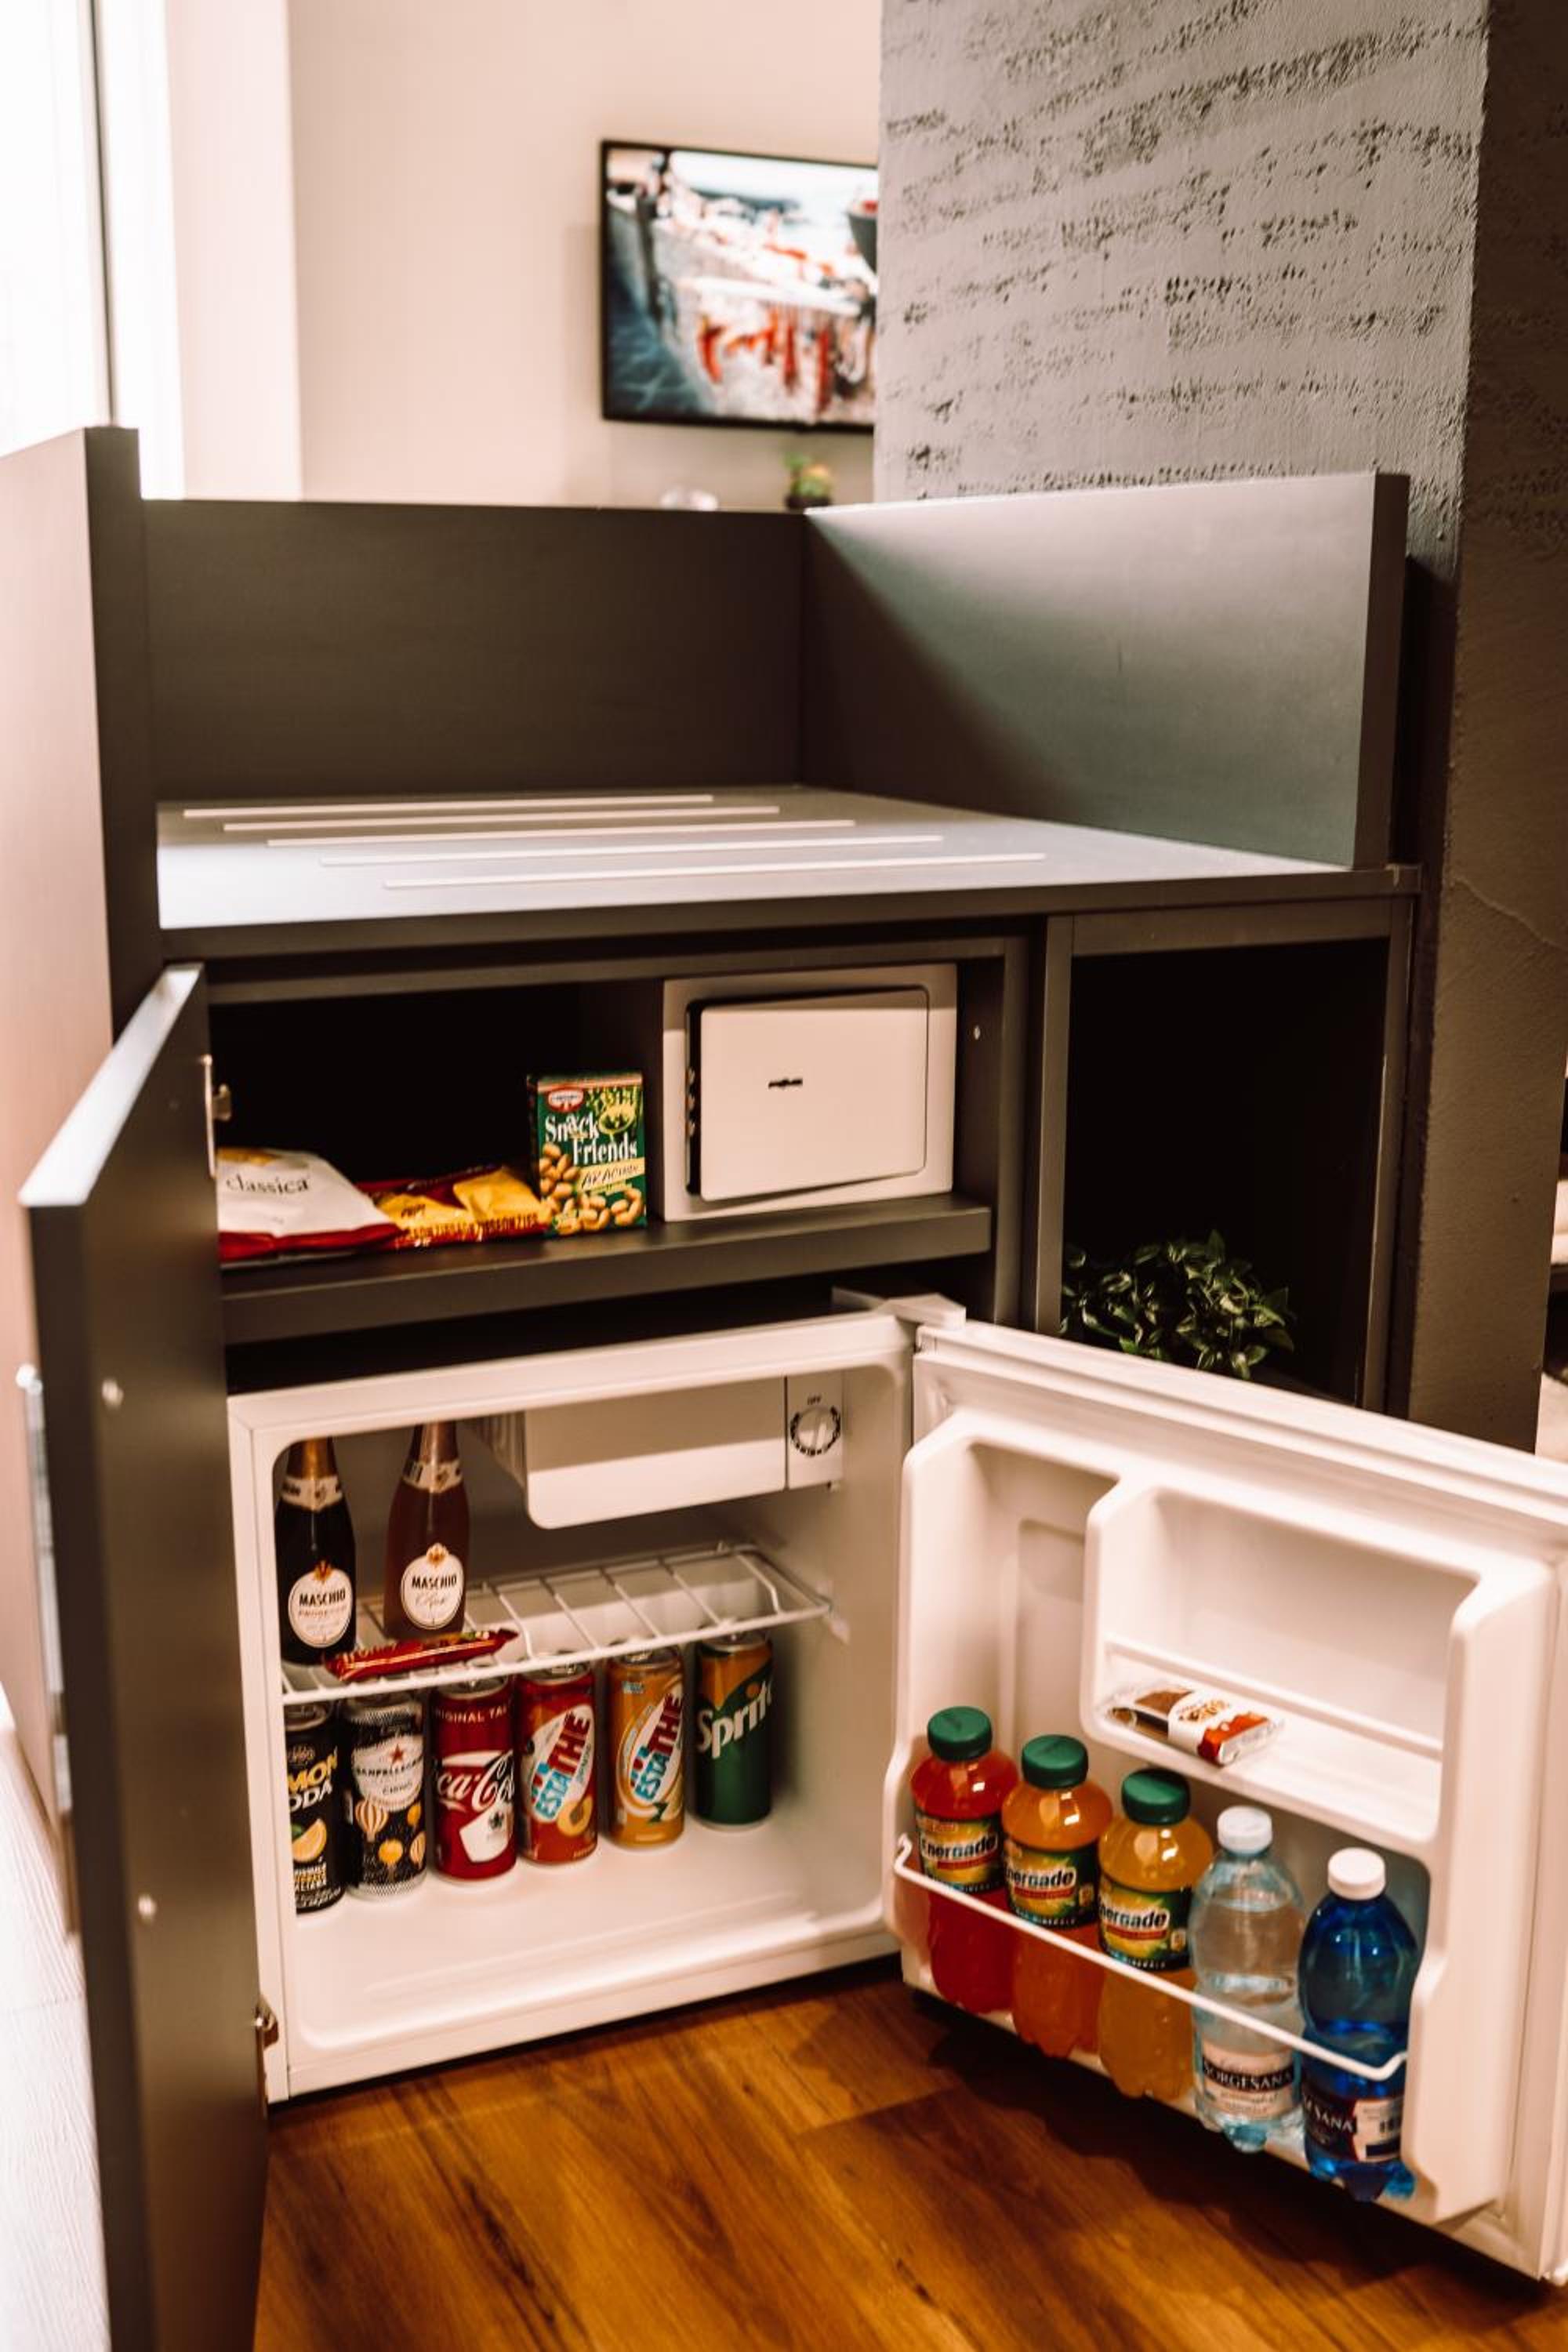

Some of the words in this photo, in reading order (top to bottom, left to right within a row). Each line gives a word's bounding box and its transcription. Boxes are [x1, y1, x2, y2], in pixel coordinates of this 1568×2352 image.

[545, 1111, 600, 1143] Snack
[573, 1131, 637, 1167] Friends
[226, 1174, 309, 1193] classica
[412, 1573, 457, 1591] MASCHIO
[299, 1588, 346, 1606] MASCHIO
[435, 1706, 485, 1724] RIGINAL
[288, 1746, 338, 1794] MON
[289, 1779, 333, 1813] ODA
[1007, 1867, 1074, 1888] nergade
[1100, 1907, 1167, 1928] nergade
